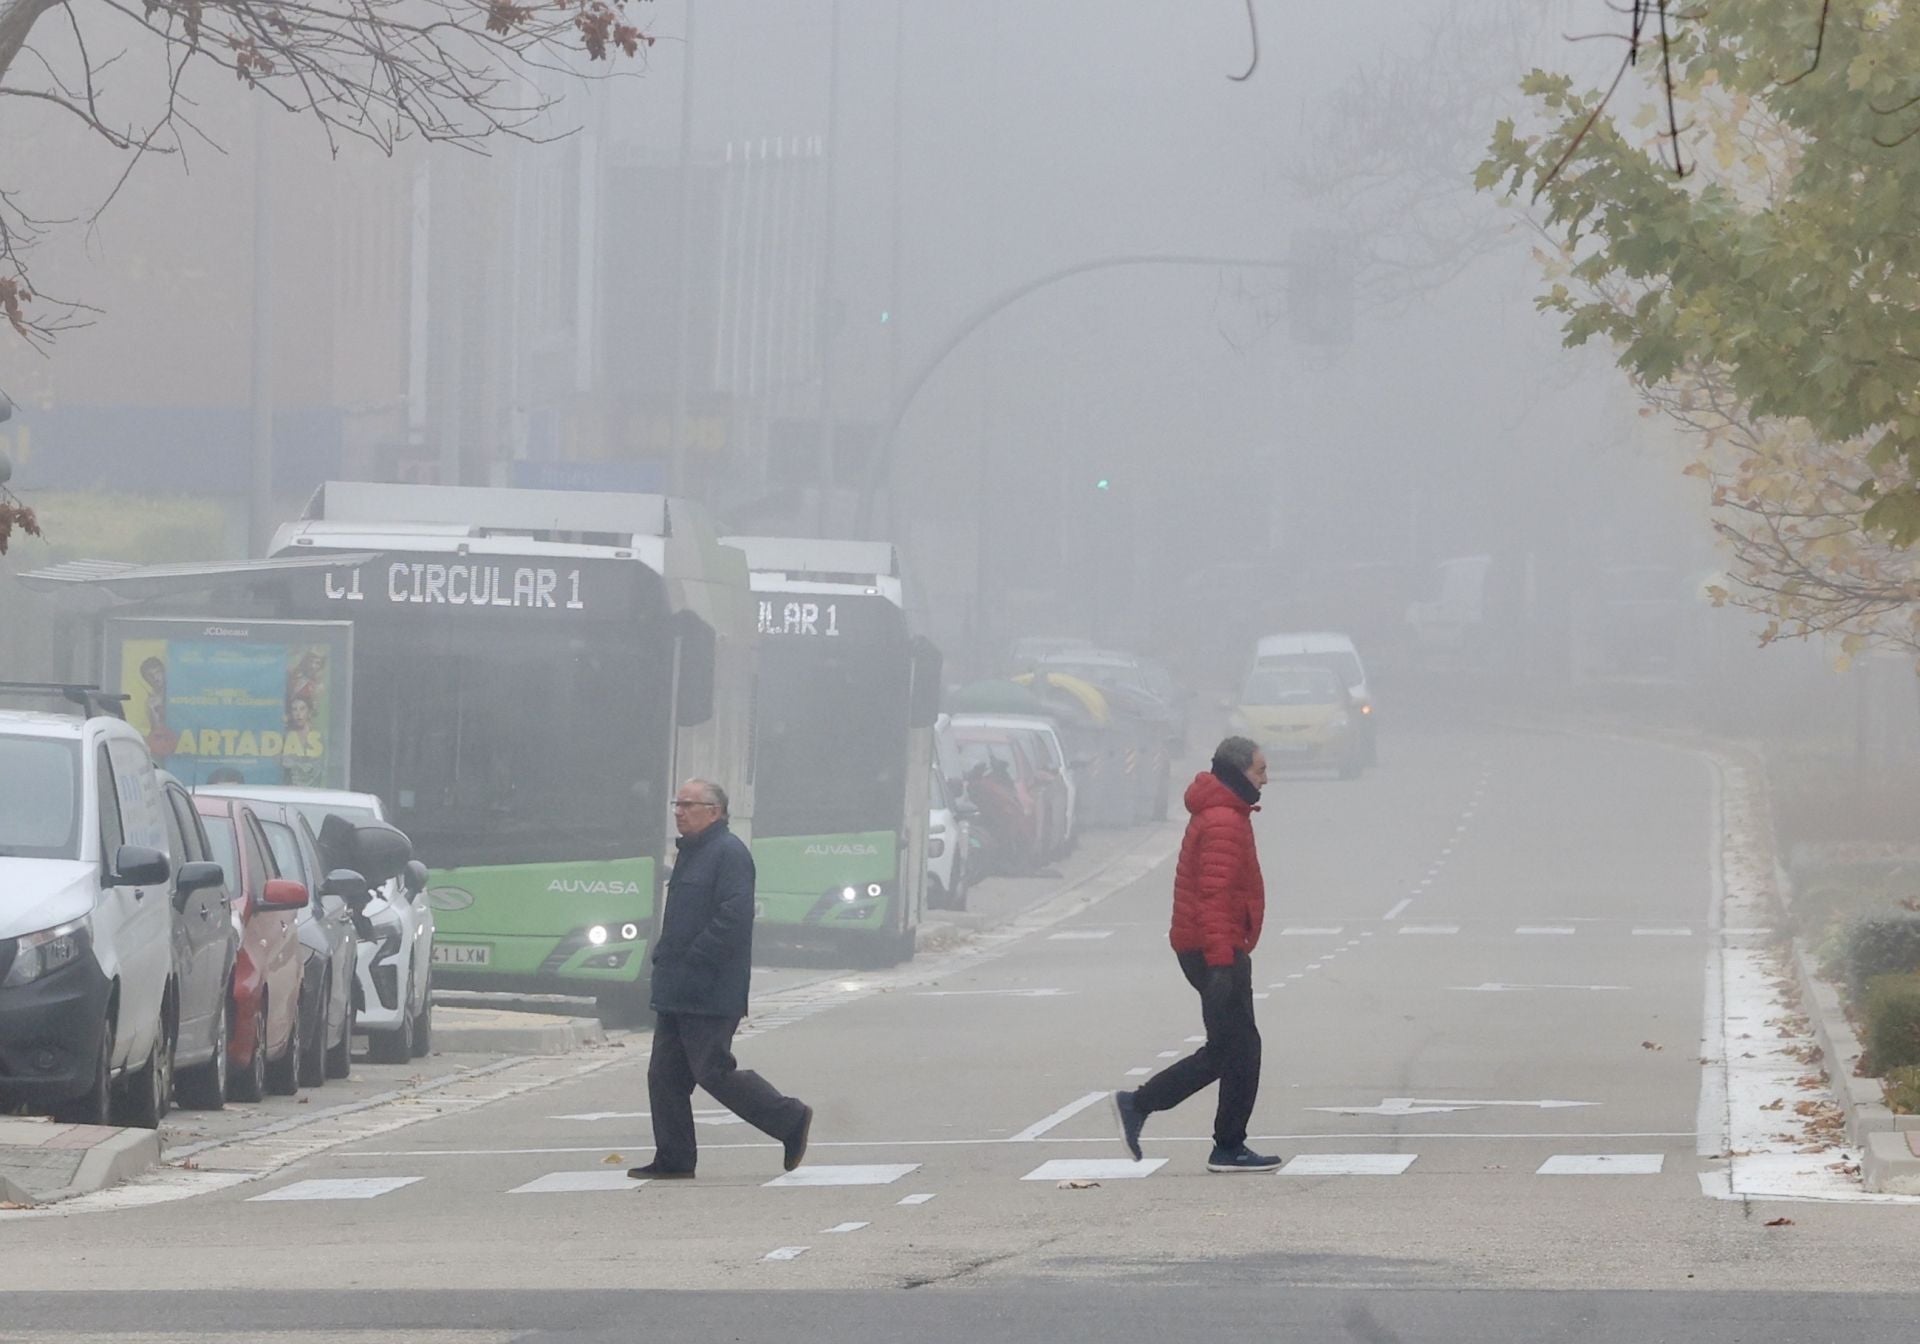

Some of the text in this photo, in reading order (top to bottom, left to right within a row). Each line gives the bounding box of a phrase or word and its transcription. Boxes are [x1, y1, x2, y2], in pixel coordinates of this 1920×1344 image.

[325, 562, 584, 609] C1 CIRCULAR 1
[825, 604, 840, 636] 1
[804, 844, 879, 855] AUVASA
[547, 879, 640, 895] AUVASA
